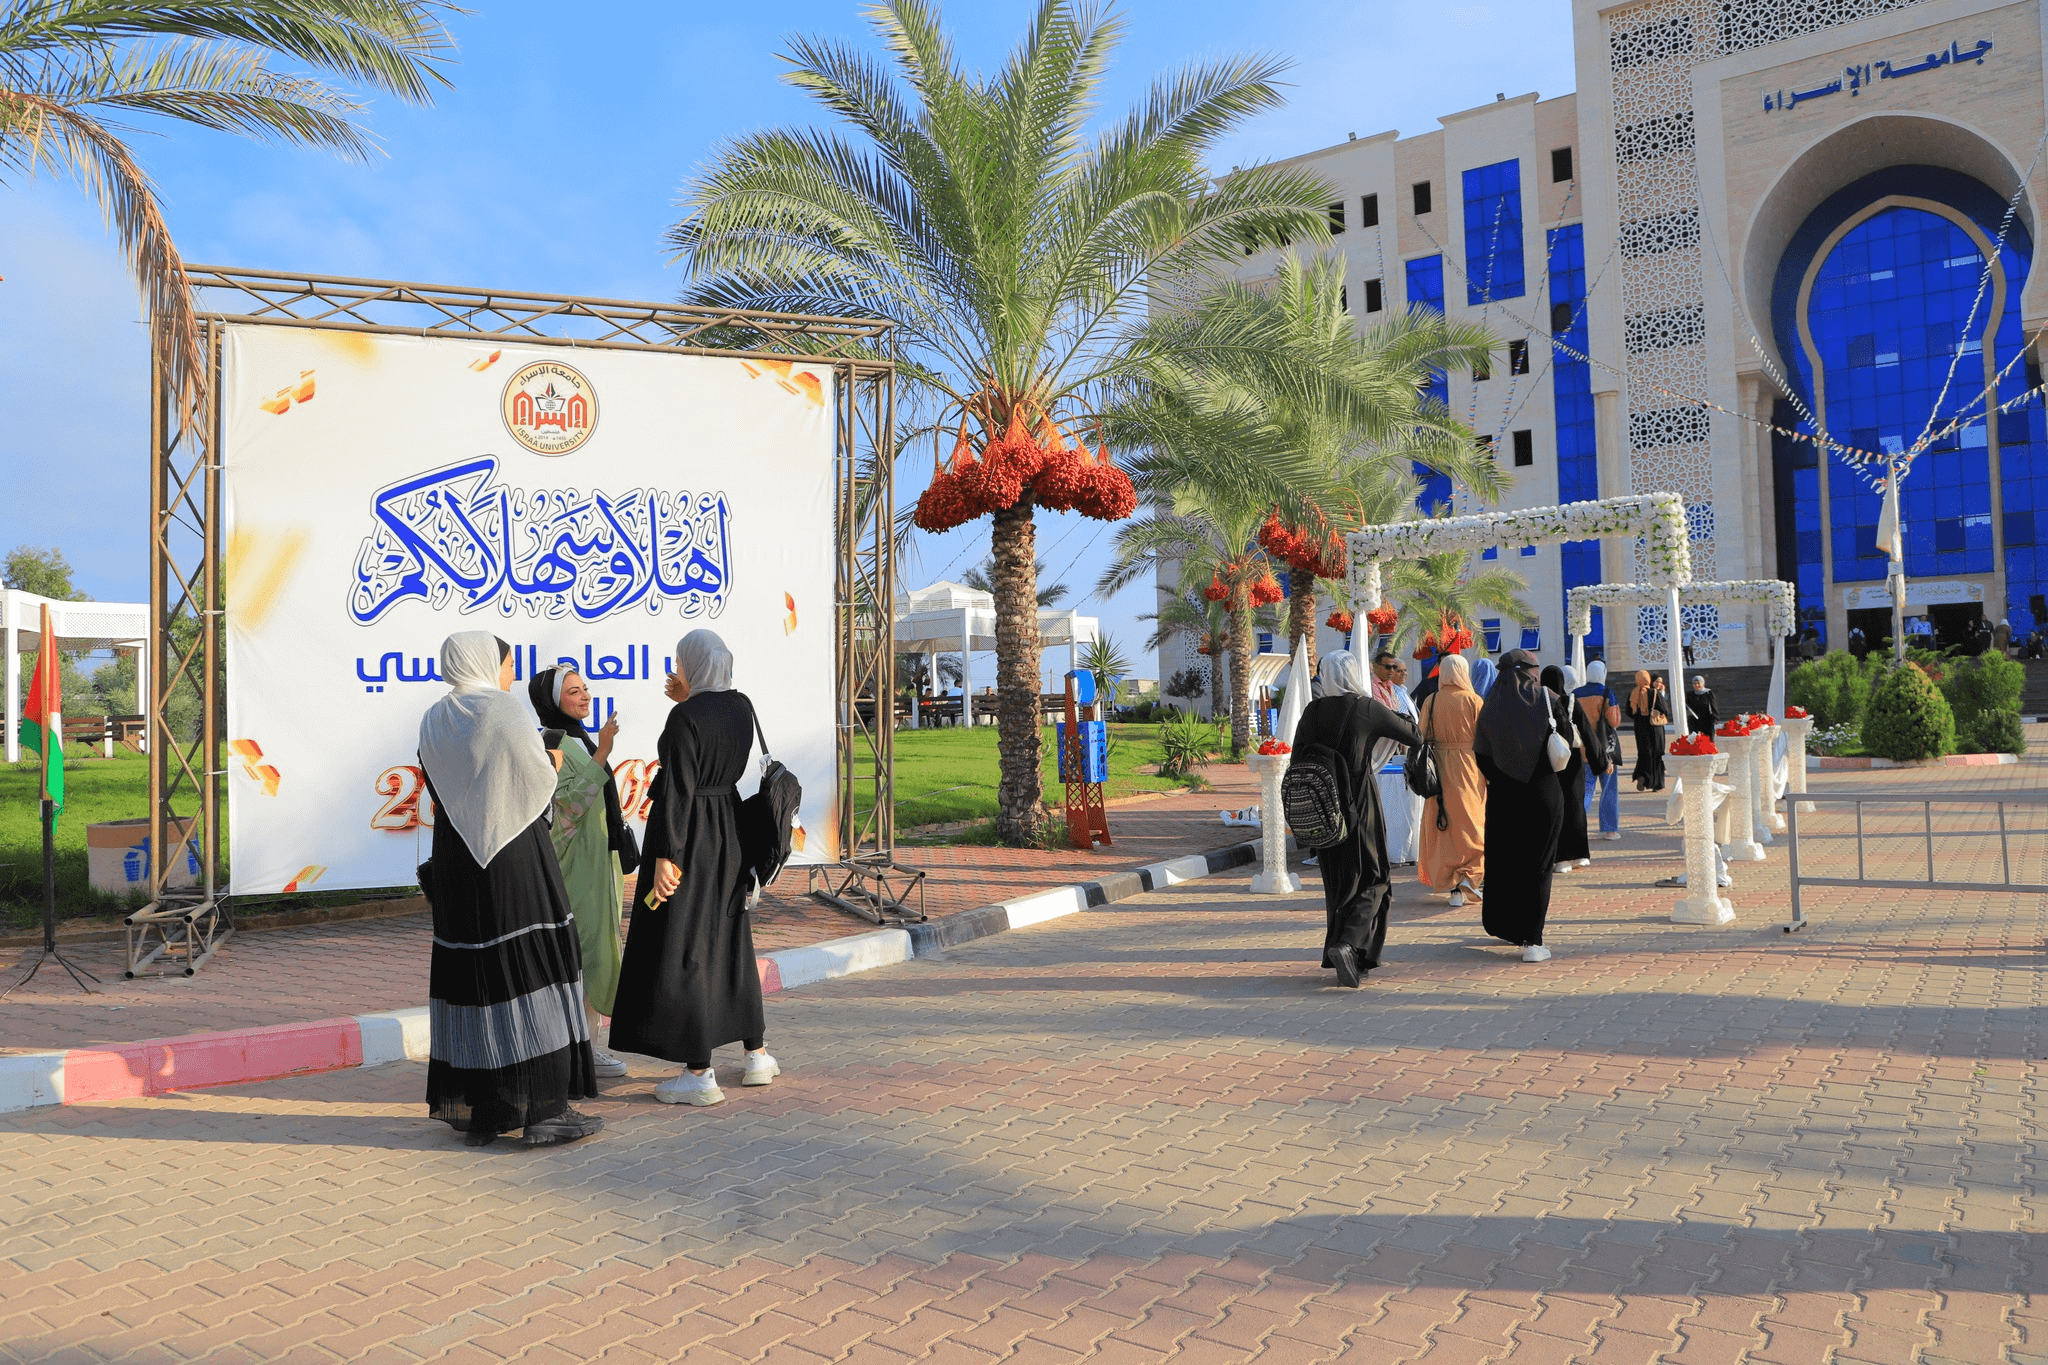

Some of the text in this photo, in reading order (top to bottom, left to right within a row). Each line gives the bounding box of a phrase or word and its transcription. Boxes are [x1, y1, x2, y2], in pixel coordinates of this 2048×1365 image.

[1763, 40, 1993, 112] جامعة الإسراء
[551, 365, 581, 389] جامعة
[517, 427, 584, 451] ISRAA UNIVERSITY
[356, 644, 537, 693] السي
